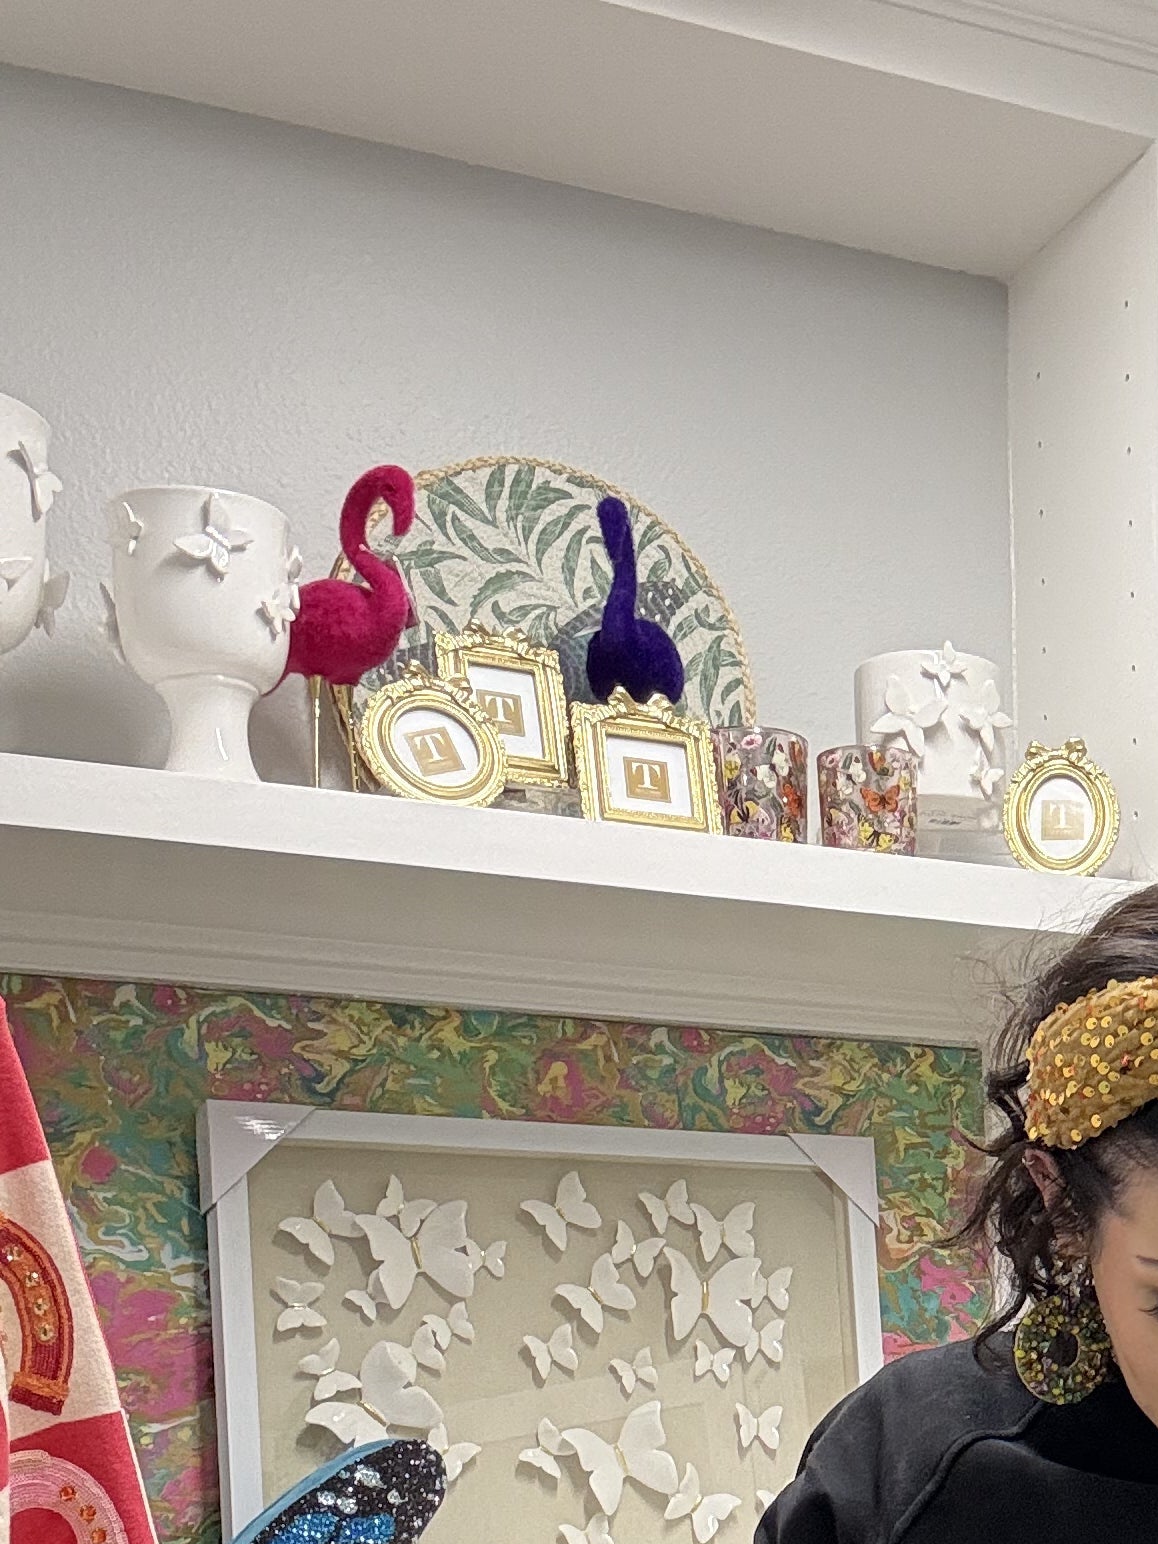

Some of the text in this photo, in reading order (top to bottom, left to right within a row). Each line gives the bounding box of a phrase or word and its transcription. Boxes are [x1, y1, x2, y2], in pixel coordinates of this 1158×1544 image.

[484, 695, 515, 723] T
[413, 733, 447, 762] T
[631, 762, 661, 789] T
[1049, 802, 1077, 829] T
